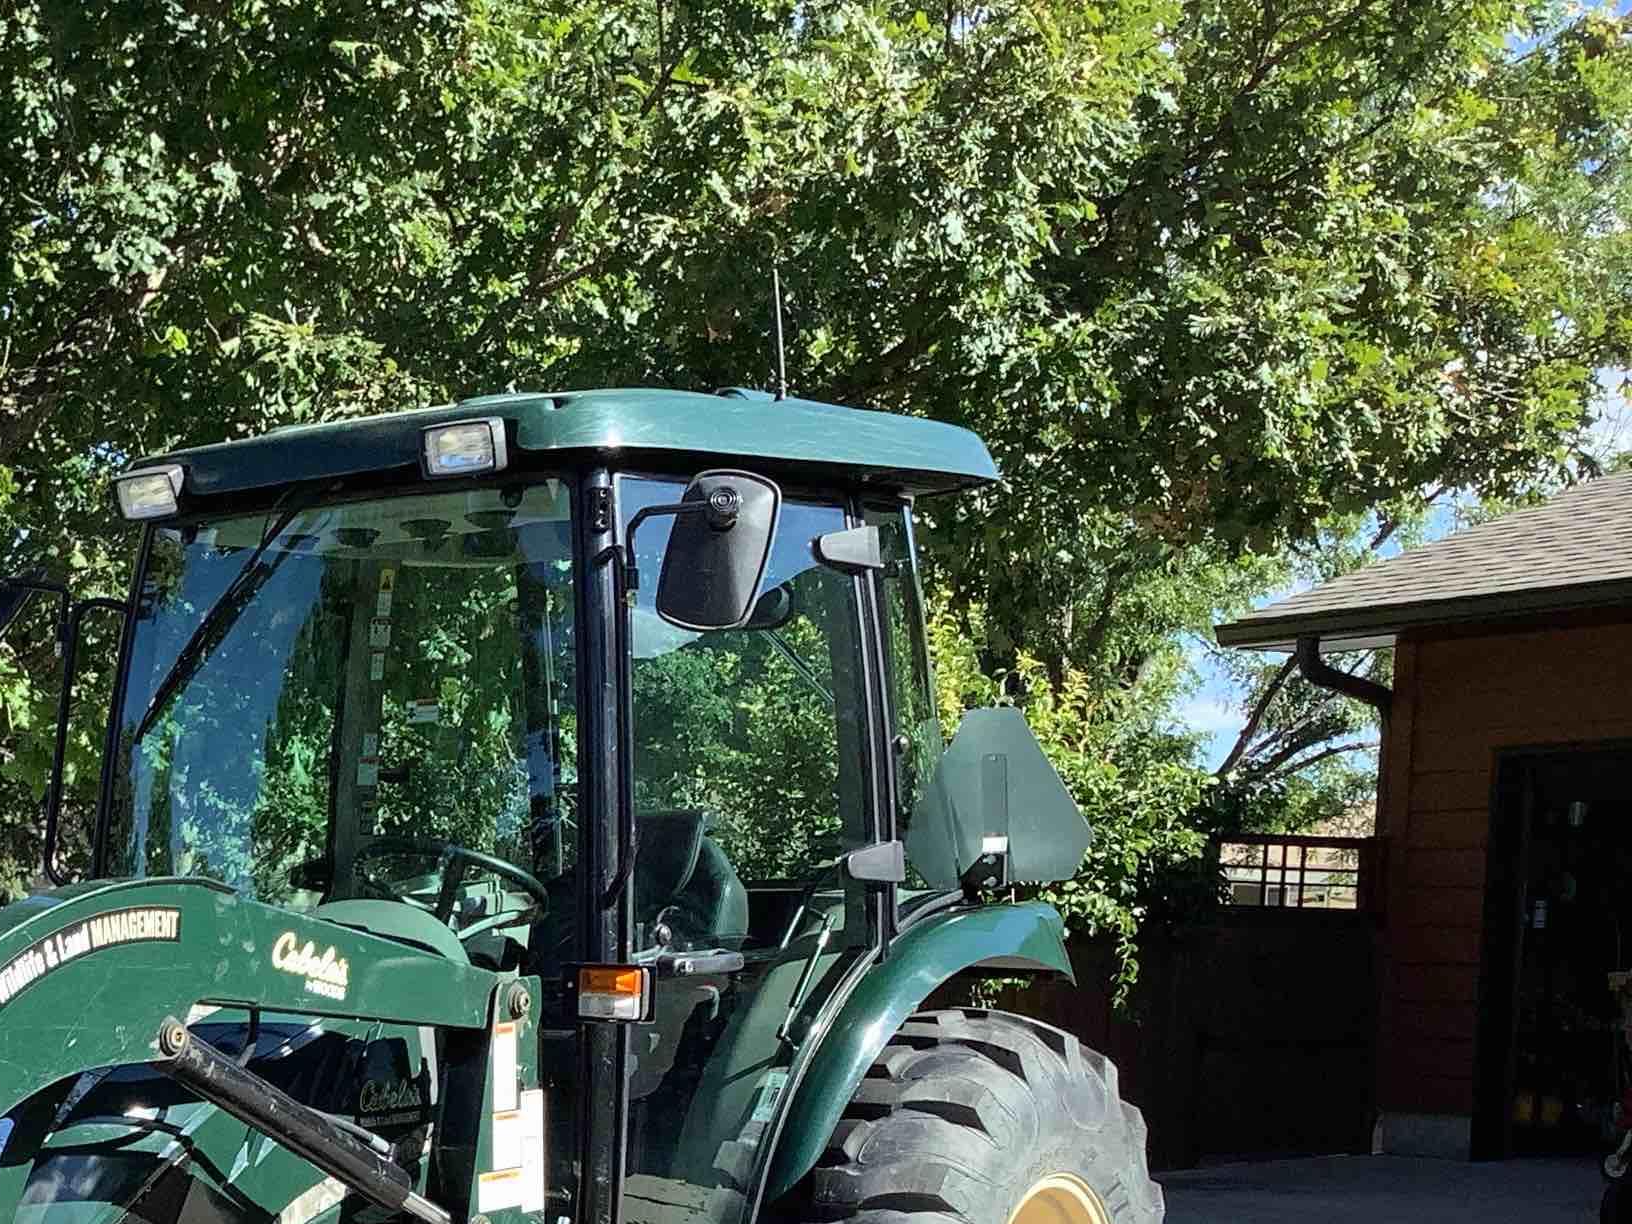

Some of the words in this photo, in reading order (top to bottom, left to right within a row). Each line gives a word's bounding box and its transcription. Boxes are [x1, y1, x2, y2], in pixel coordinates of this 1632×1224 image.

[44, 941, 59, 967] &
[56, 923, 91, 961] Land
[90, 911, 180, 948] MANAGEMENT
